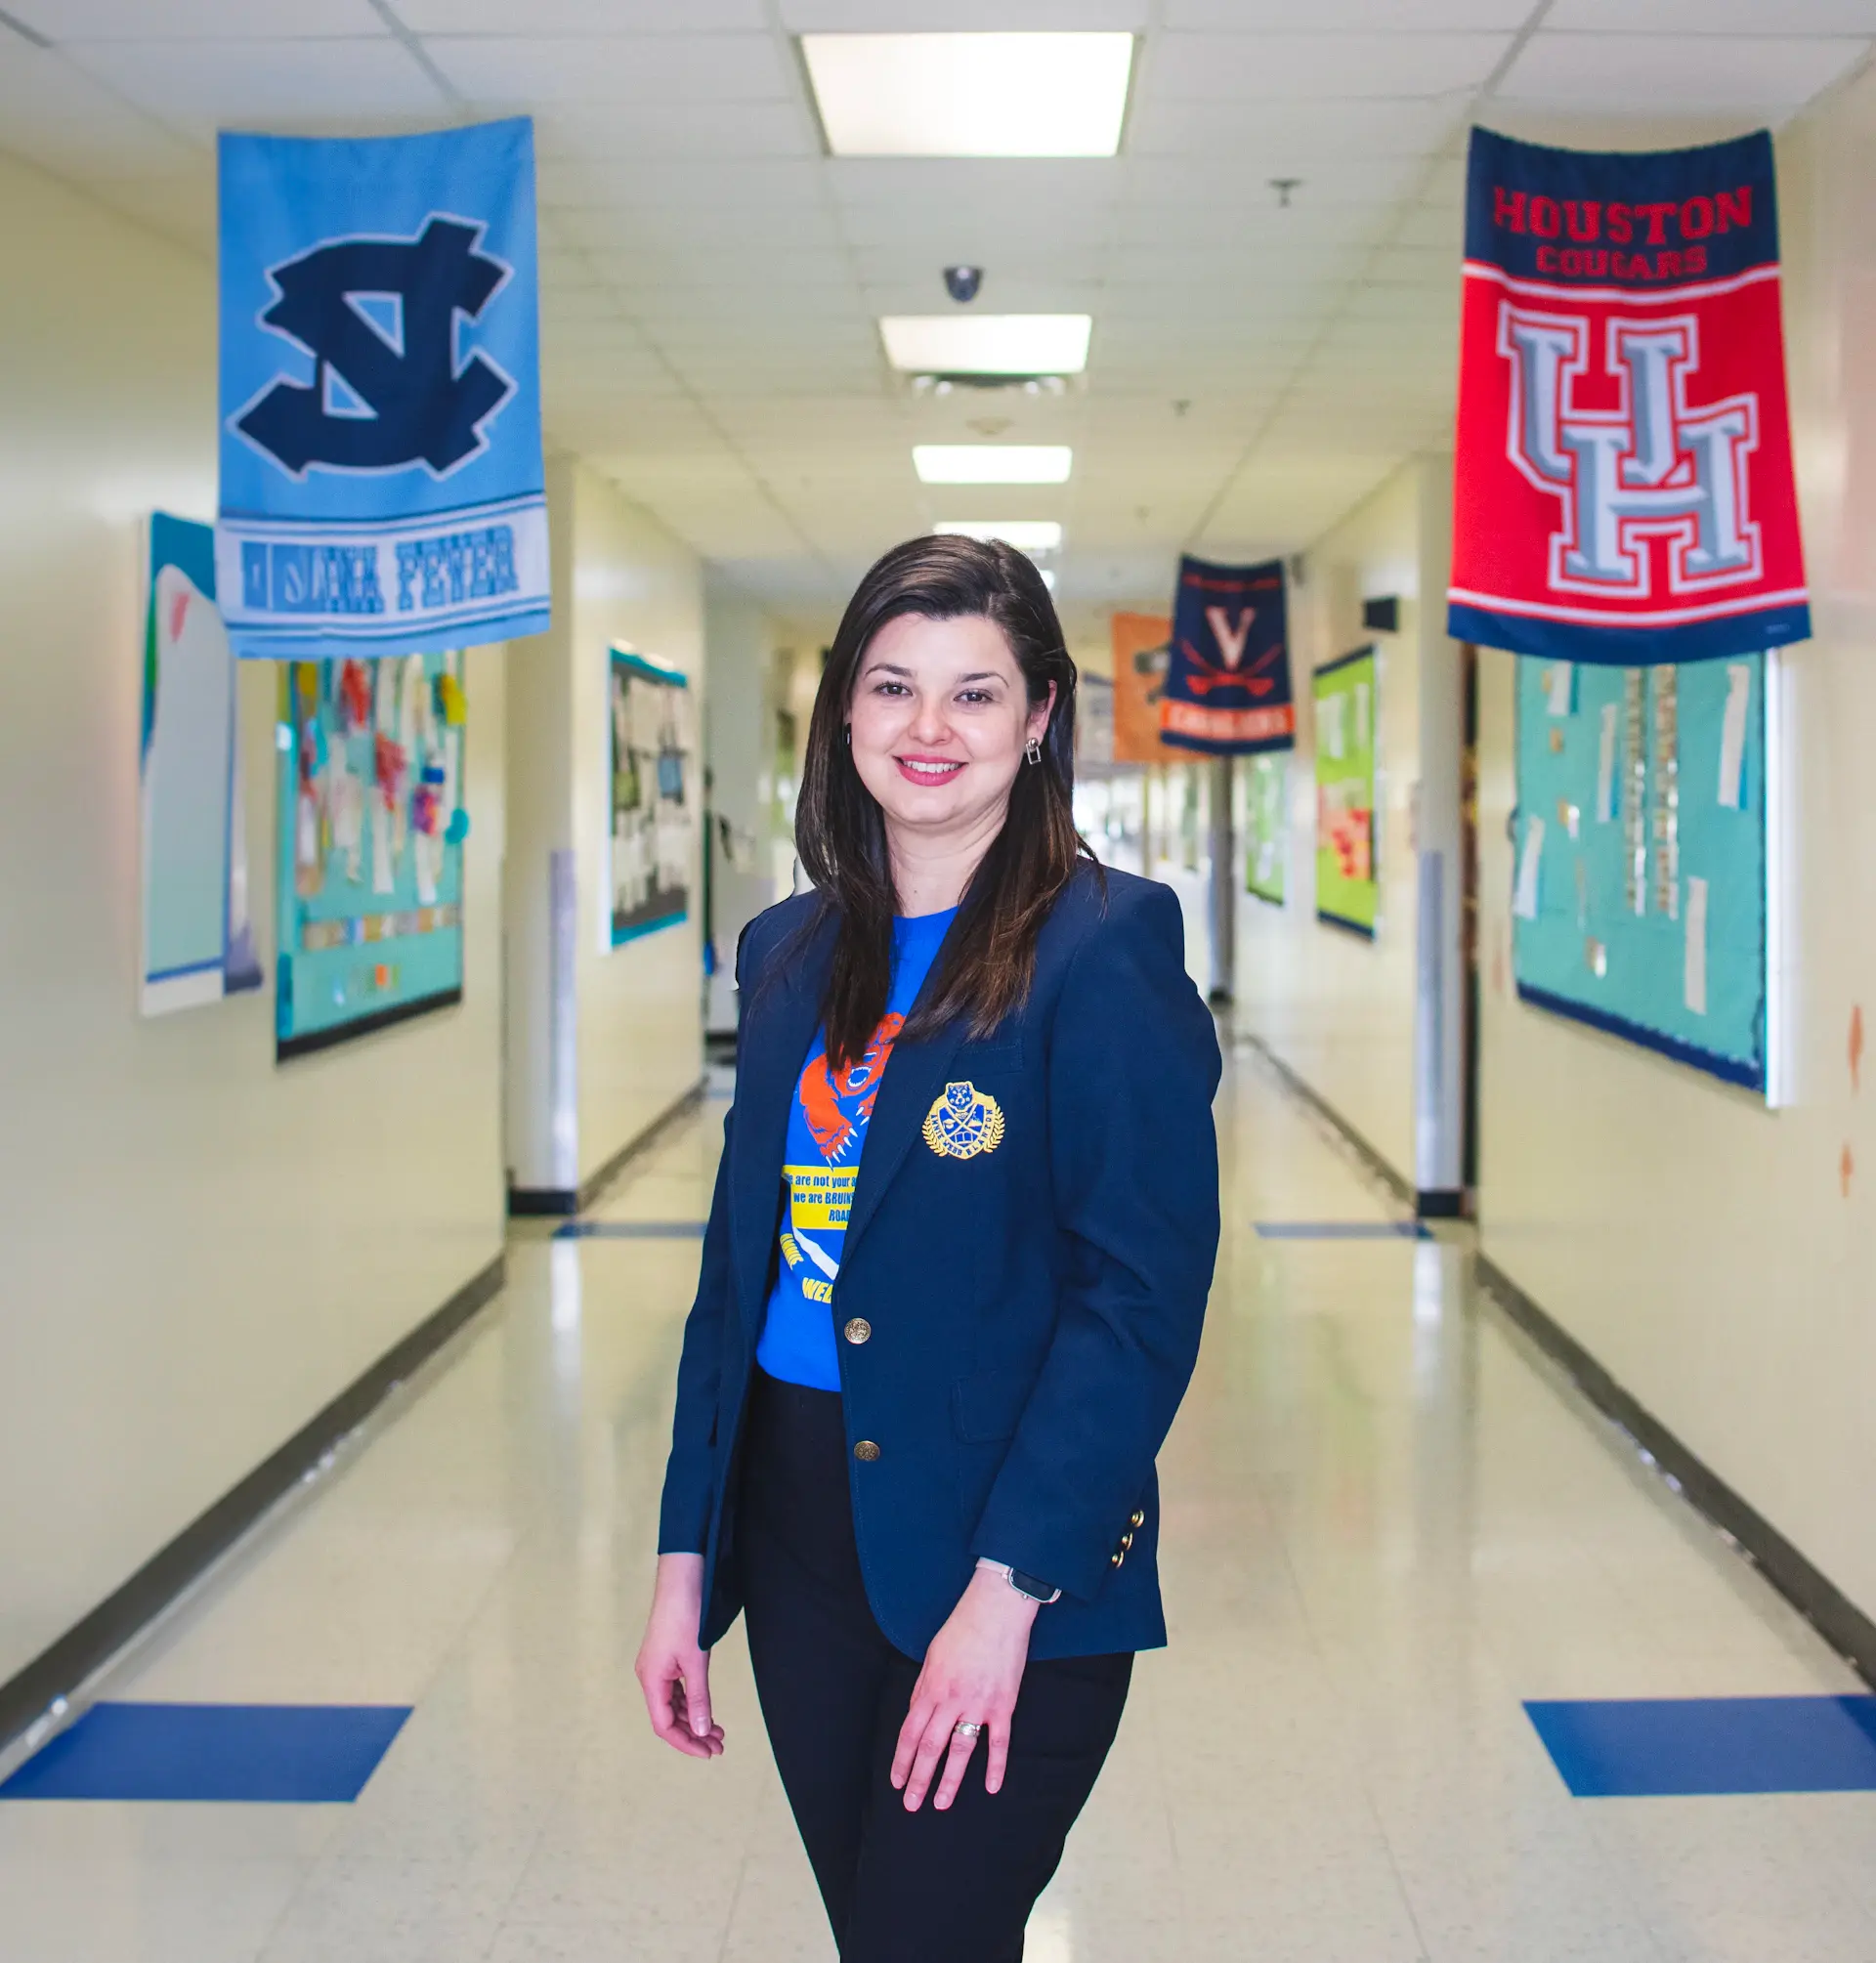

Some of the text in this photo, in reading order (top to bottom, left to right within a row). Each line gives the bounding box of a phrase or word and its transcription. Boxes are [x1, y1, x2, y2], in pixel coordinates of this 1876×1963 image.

[1494, 186, 1754, 245] HOUSTON
[1535, 245, 1708, 280] COUGARS
[795, 1175, 811, 1186] are
[813, 1175, 830, 1187] not
[831, 1176, 850, 1188] your
[793, 1192, 806, 1203] we
[808, 1193, 823, 1204] are
